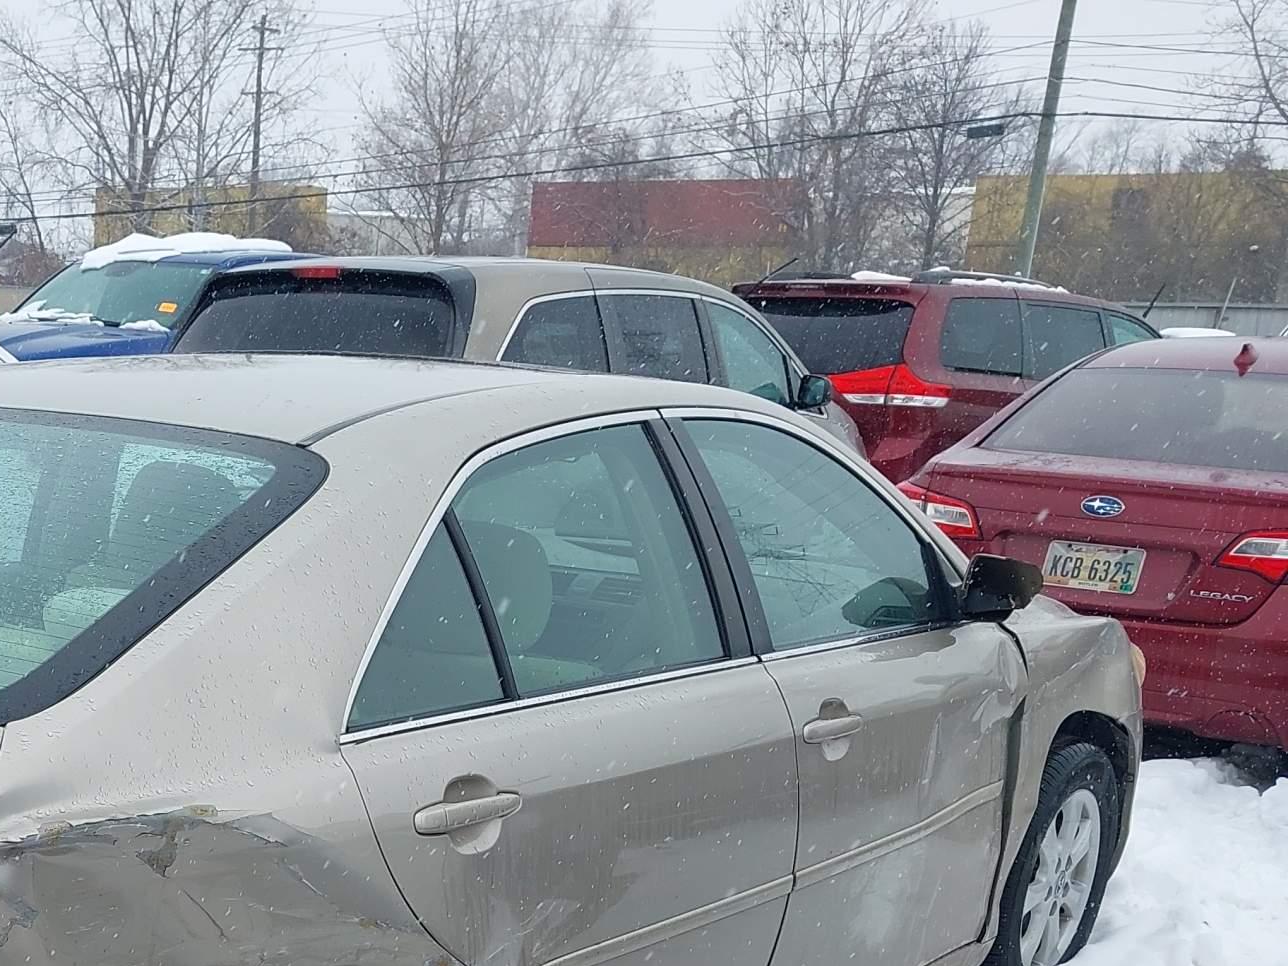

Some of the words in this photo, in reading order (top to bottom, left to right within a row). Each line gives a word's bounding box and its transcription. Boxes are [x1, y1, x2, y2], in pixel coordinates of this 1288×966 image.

[1049, 554, 1084, 579] KCB
[1087, 558, 1134, 585] 6325
[1190, 589, 1254, 603] LEGACY
